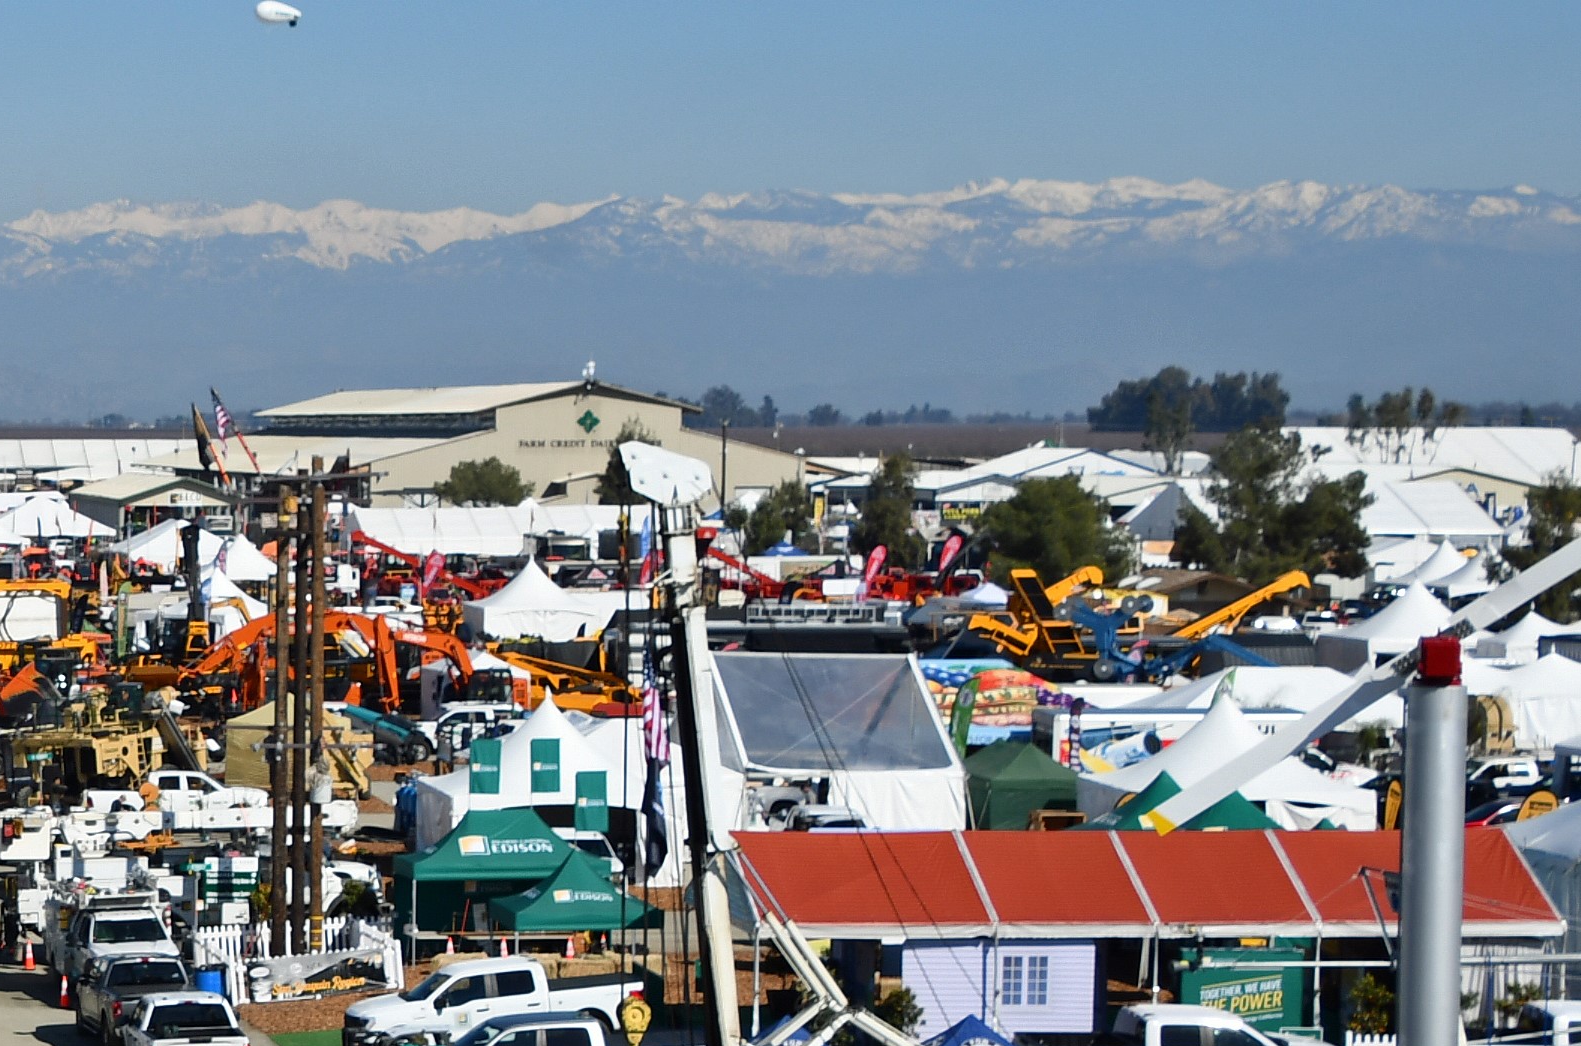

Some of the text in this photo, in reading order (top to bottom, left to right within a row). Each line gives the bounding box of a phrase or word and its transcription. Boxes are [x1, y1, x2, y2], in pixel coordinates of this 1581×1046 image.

[519, 440, 618, 448] FARM CREDIT DAIR
[491, 843, 554, 853] EDISON
[273, 984, 292, 995] San
[332, 976, 366, 990] Region
[1244, 982, 1259, 993] WE
[1259, 979, 1282, 991] HAVE
[1230, 990, 1284, 1012] POWER
